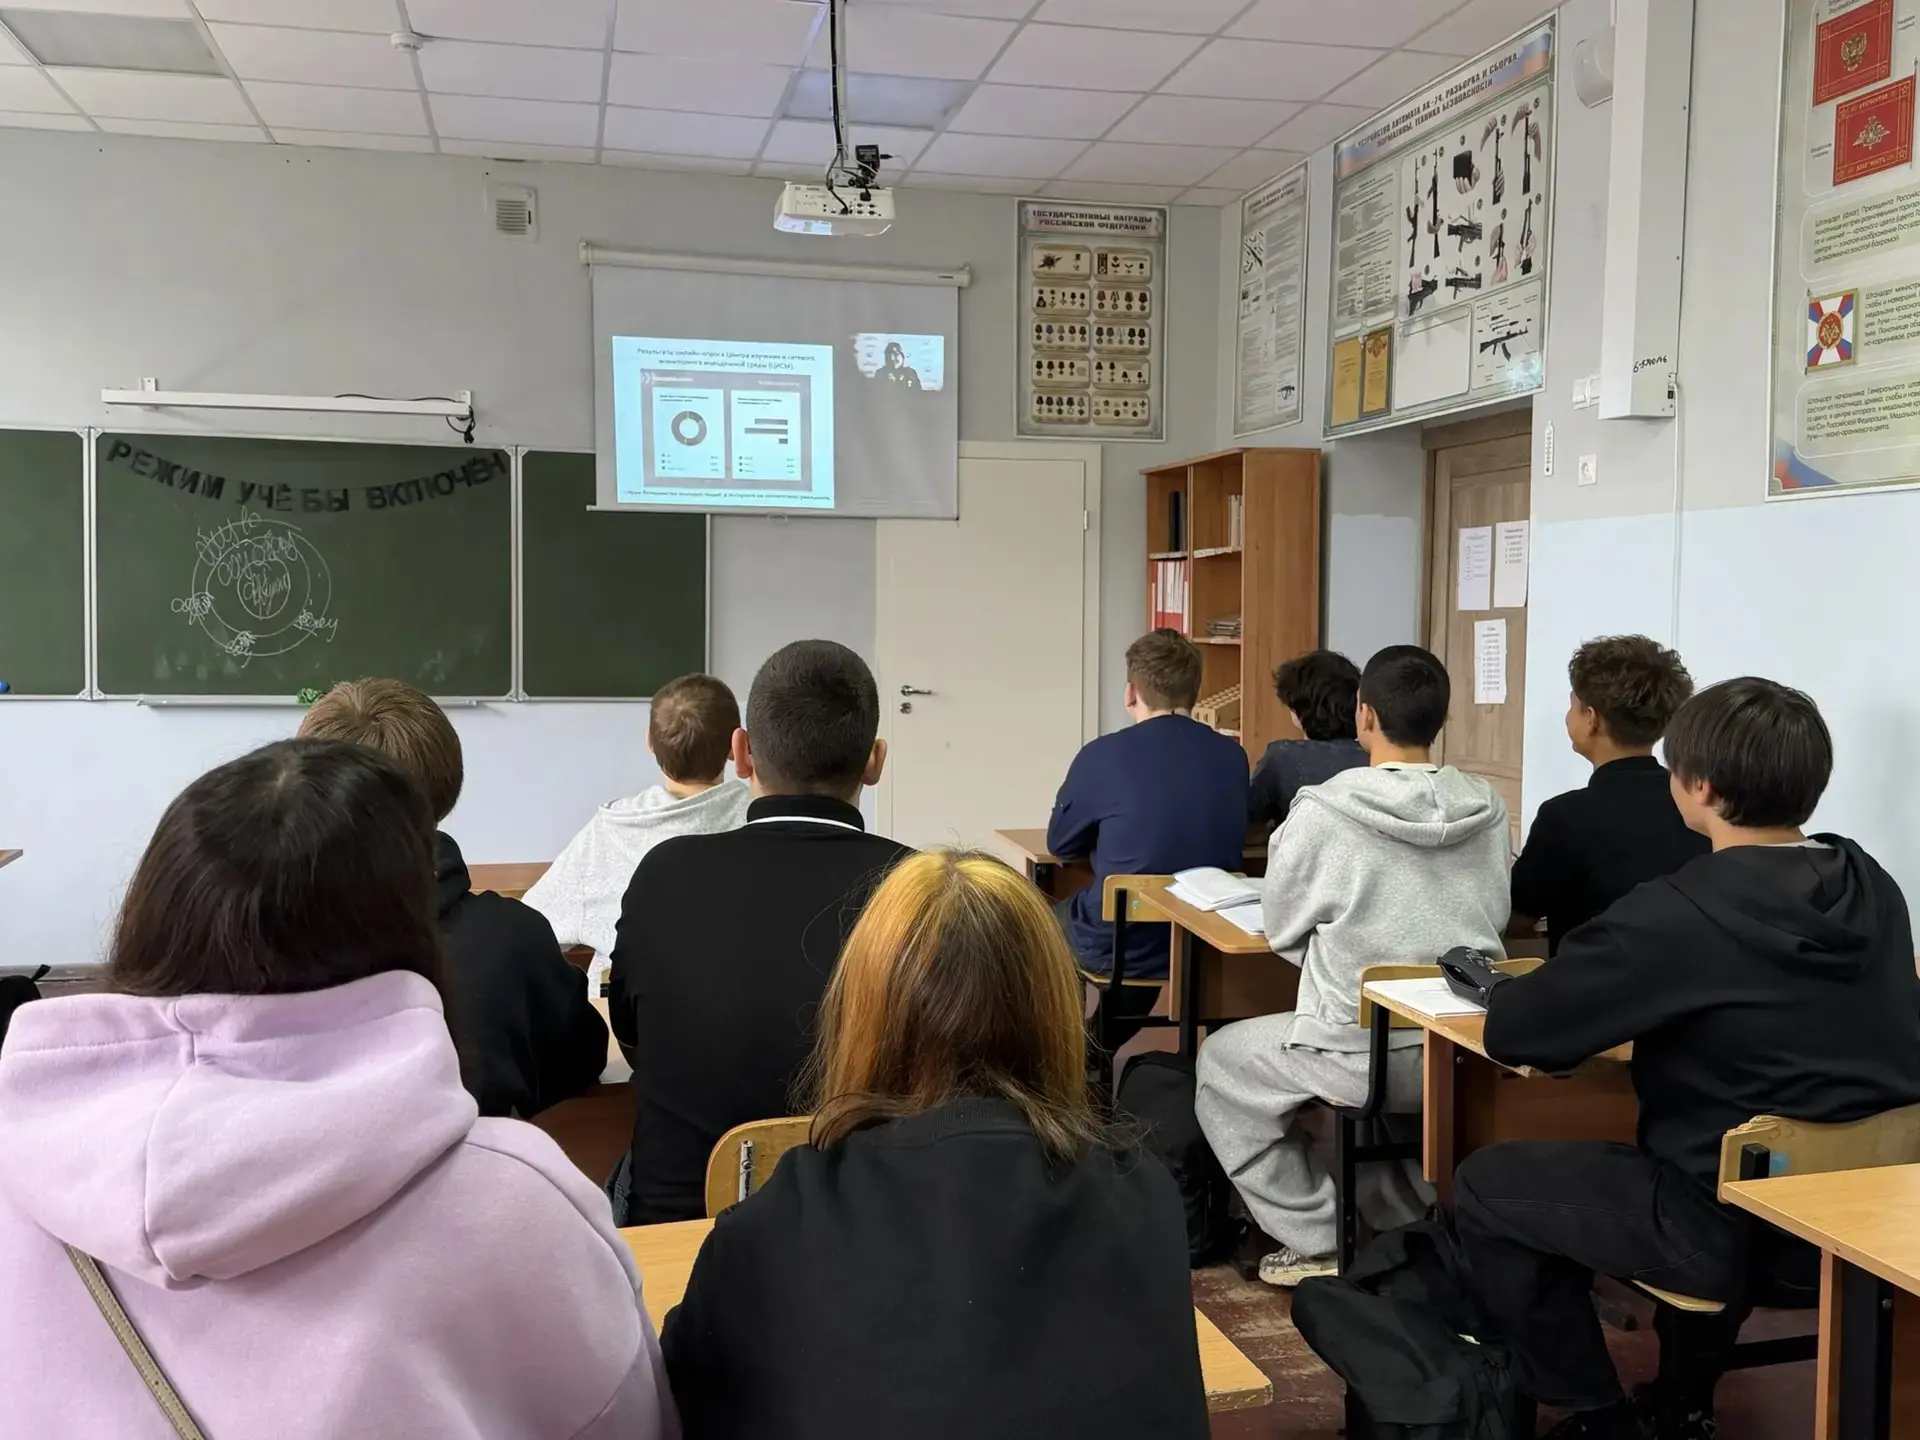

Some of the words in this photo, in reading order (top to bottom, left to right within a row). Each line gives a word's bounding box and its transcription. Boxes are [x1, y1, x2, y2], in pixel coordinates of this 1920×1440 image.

[1392, 106, 1420, 129] АВТОМАТА
[1445, 73, 1480, 98] РАЗБОРКА
[1482, 69, 1488, 79] И
[1415, 106, 1440, 126] ТЕХНИКА
[1442, 78, 1492, 111] БЕЗОПАСНОСТИ
[1032, 210, 1110, 220] ГОСУДАРСТВЕННЫЕ
[1113, 215, 1152, 223] НАГРАДЫ
[1039, 219, 1094, 228] РОССИЙСКОЙ
[1098, 222, 1146, 231] ФЕДЕРАЦИИ
[1865, 289, 1892, 300] Штандарт
[726, 351, 749, 360] Центра
[1867, 384, 1905, 395] Генерального
[1826, 418, 1856, 429] Российской
[1890, 410, 1917, 421] Медальон
[106, 439, 226, 500] РЕЖИМ
[236, 481, 349, 513] УЧЁБЫ
[366, 452, 507, 510] ВКЛЮЧЁН
